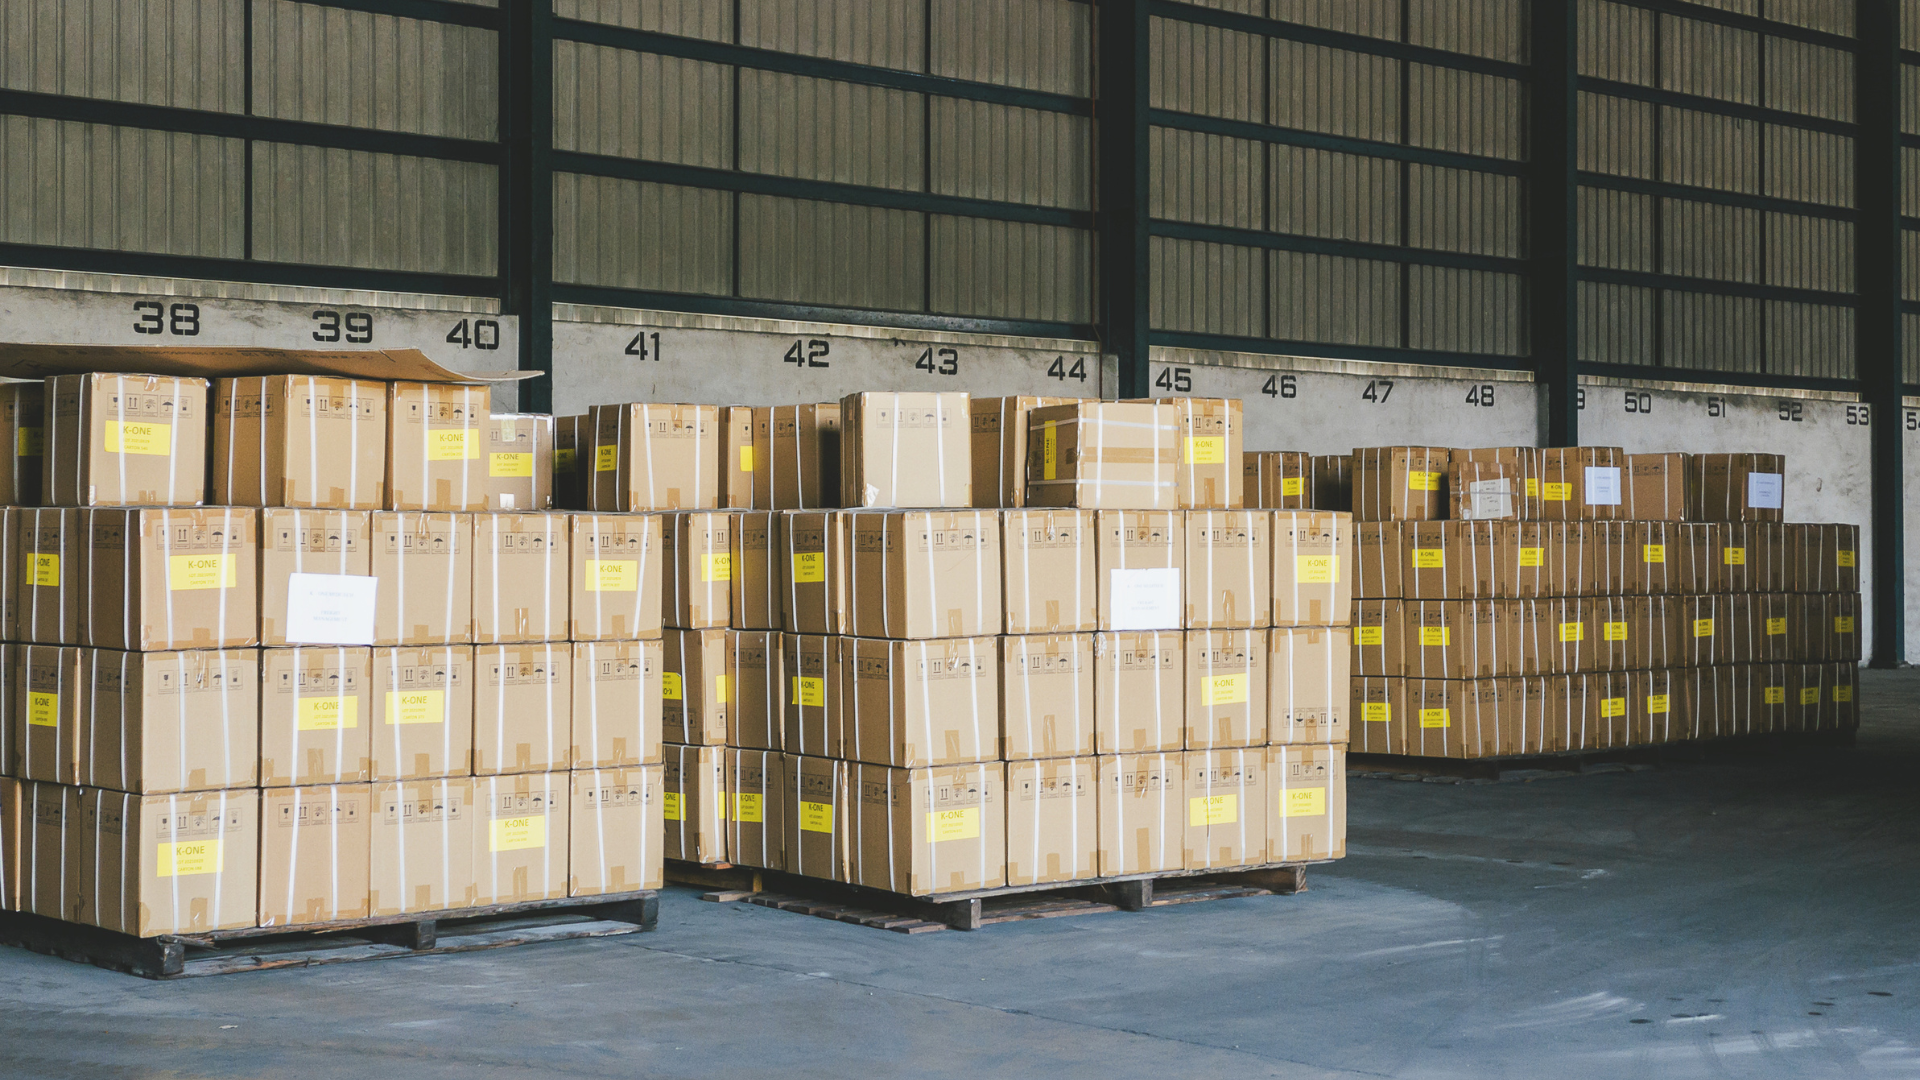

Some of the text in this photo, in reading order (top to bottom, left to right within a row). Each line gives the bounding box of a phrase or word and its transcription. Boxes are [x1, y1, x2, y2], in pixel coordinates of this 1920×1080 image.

[133, 300, 200, 336] 38
[311, 311, 373, 343] 39
[446, 319, 499, 350] 40
[625, 332, 660, 361] 41
[784, 340, 829, 368] 42
[915, 348, 959, 376] 43
[1047, 356, 1087, 383] 44
[1156, 367, 1192, 393] 45
[1262, 375, 1297, 399] 46
[1362, 381, 1394, 404] 47
[1465, 385, 1495, 407] 48
[1624, 391, 1652, 414] 50
[1708, 397, 1726, 418] 51
[1778, 401, 1804, 422] 52
[1846, 405, 1870, 426] 53
[123, 426, 152, 436] K-ONE
[1906, 411, 1920, 431] 5
[439, 434, 464, 442] K-ONE
[188, 560, 217, 569] K-ONE
[802, 554, 816, 562] K-ONE
[599, 565, 623, 573] K-ONE
[1214, 679, 1235, 687] K-ONE
[35, 698, 49, 706] K-ONE
[313, 702, 339, 711] K-ONE
[401, 696, 428, 704] K-ONE
[1292, 792, 1312, 800] K-ONE
[809, 804, 824, 812] K-ONE
[941, 811, 964, 820] K-ONE
[504, 819, 530, 828] K-ONE
[176, 846, 205, 856] K-ONE
